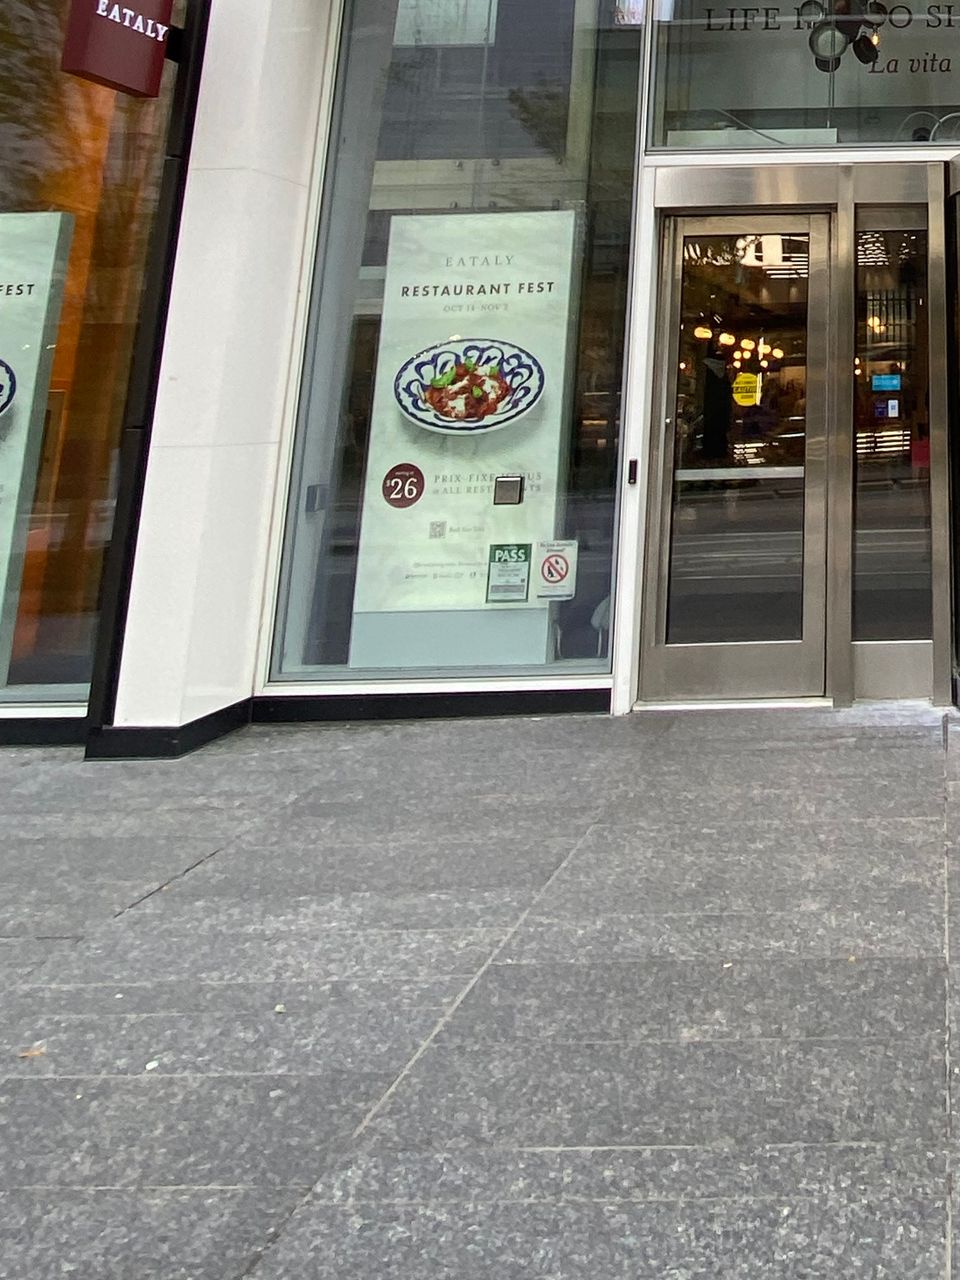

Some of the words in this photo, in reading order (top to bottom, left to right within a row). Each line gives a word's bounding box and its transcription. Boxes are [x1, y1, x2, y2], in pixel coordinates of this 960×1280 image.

[703, 8, 781, 31] LIFE
[868, 50, 899, 74] La
[908, 52, 952, 73] vita
[445, 255, 515, 268] EATALY
[401, 283, 511, 298] RESTAURANT
[518, 281, 555, 294] FEST
[495, 549, 526, 562] PASS
